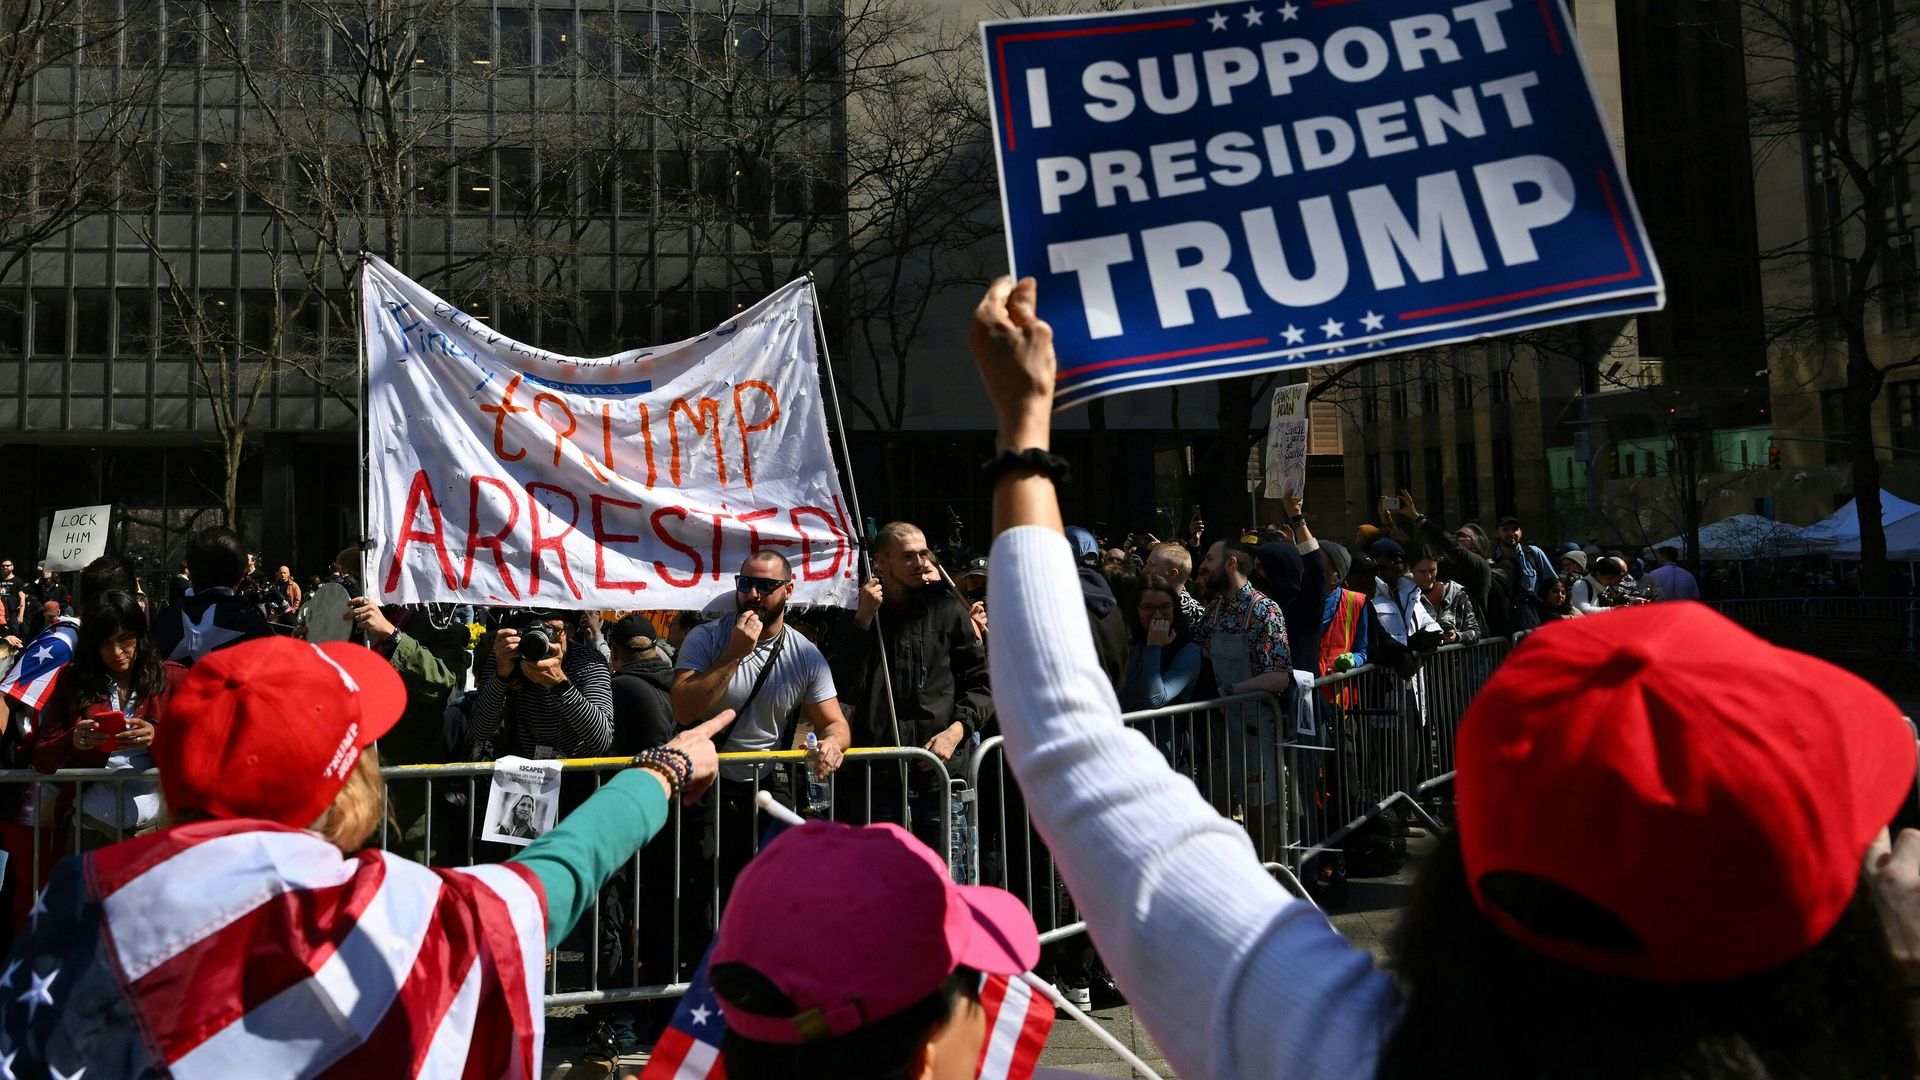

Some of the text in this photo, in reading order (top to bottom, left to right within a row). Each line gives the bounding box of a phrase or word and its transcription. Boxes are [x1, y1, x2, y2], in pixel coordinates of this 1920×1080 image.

[1025, 0, 1514, 129] I SUPPORT
[1036, 70, 1540, 215] PRESIDENT
[1047, 154, 1577, 340] TRUMP
[61, 513, 97, 528] LOCK
[62, 547, 82, 560] UP
[65, 531, 91, 544] HIM
[384, 469, 853, 600] ARRESTED!
[322, 722, 359, 779] TRUMP
